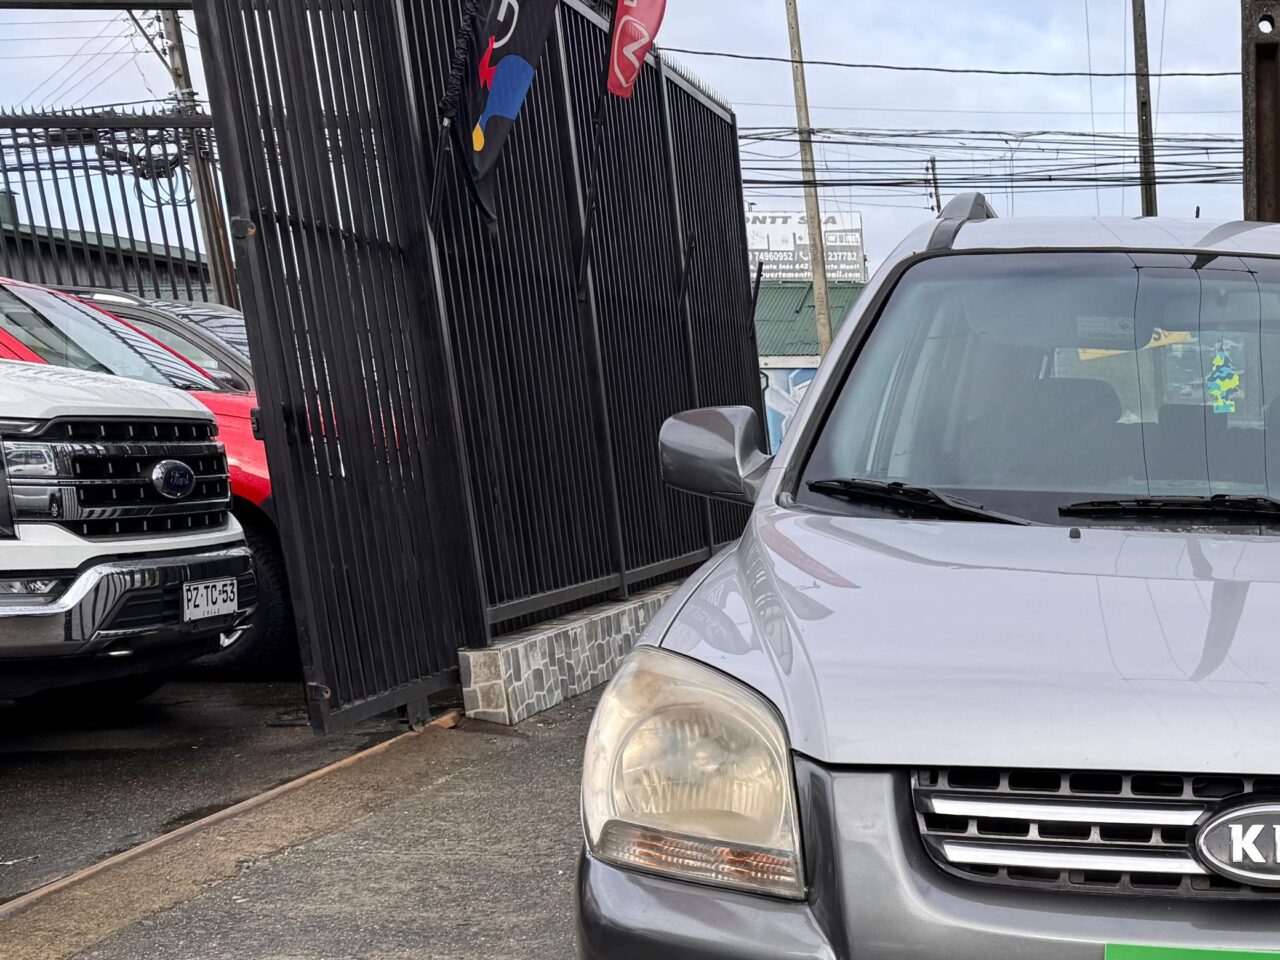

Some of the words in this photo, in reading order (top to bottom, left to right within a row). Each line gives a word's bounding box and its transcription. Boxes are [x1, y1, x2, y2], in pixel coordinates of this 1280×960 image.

[798, 215, 837, 225] SA
[754, 251, 793, 261] 74960952
[827, 251, 857, 261] 237782
